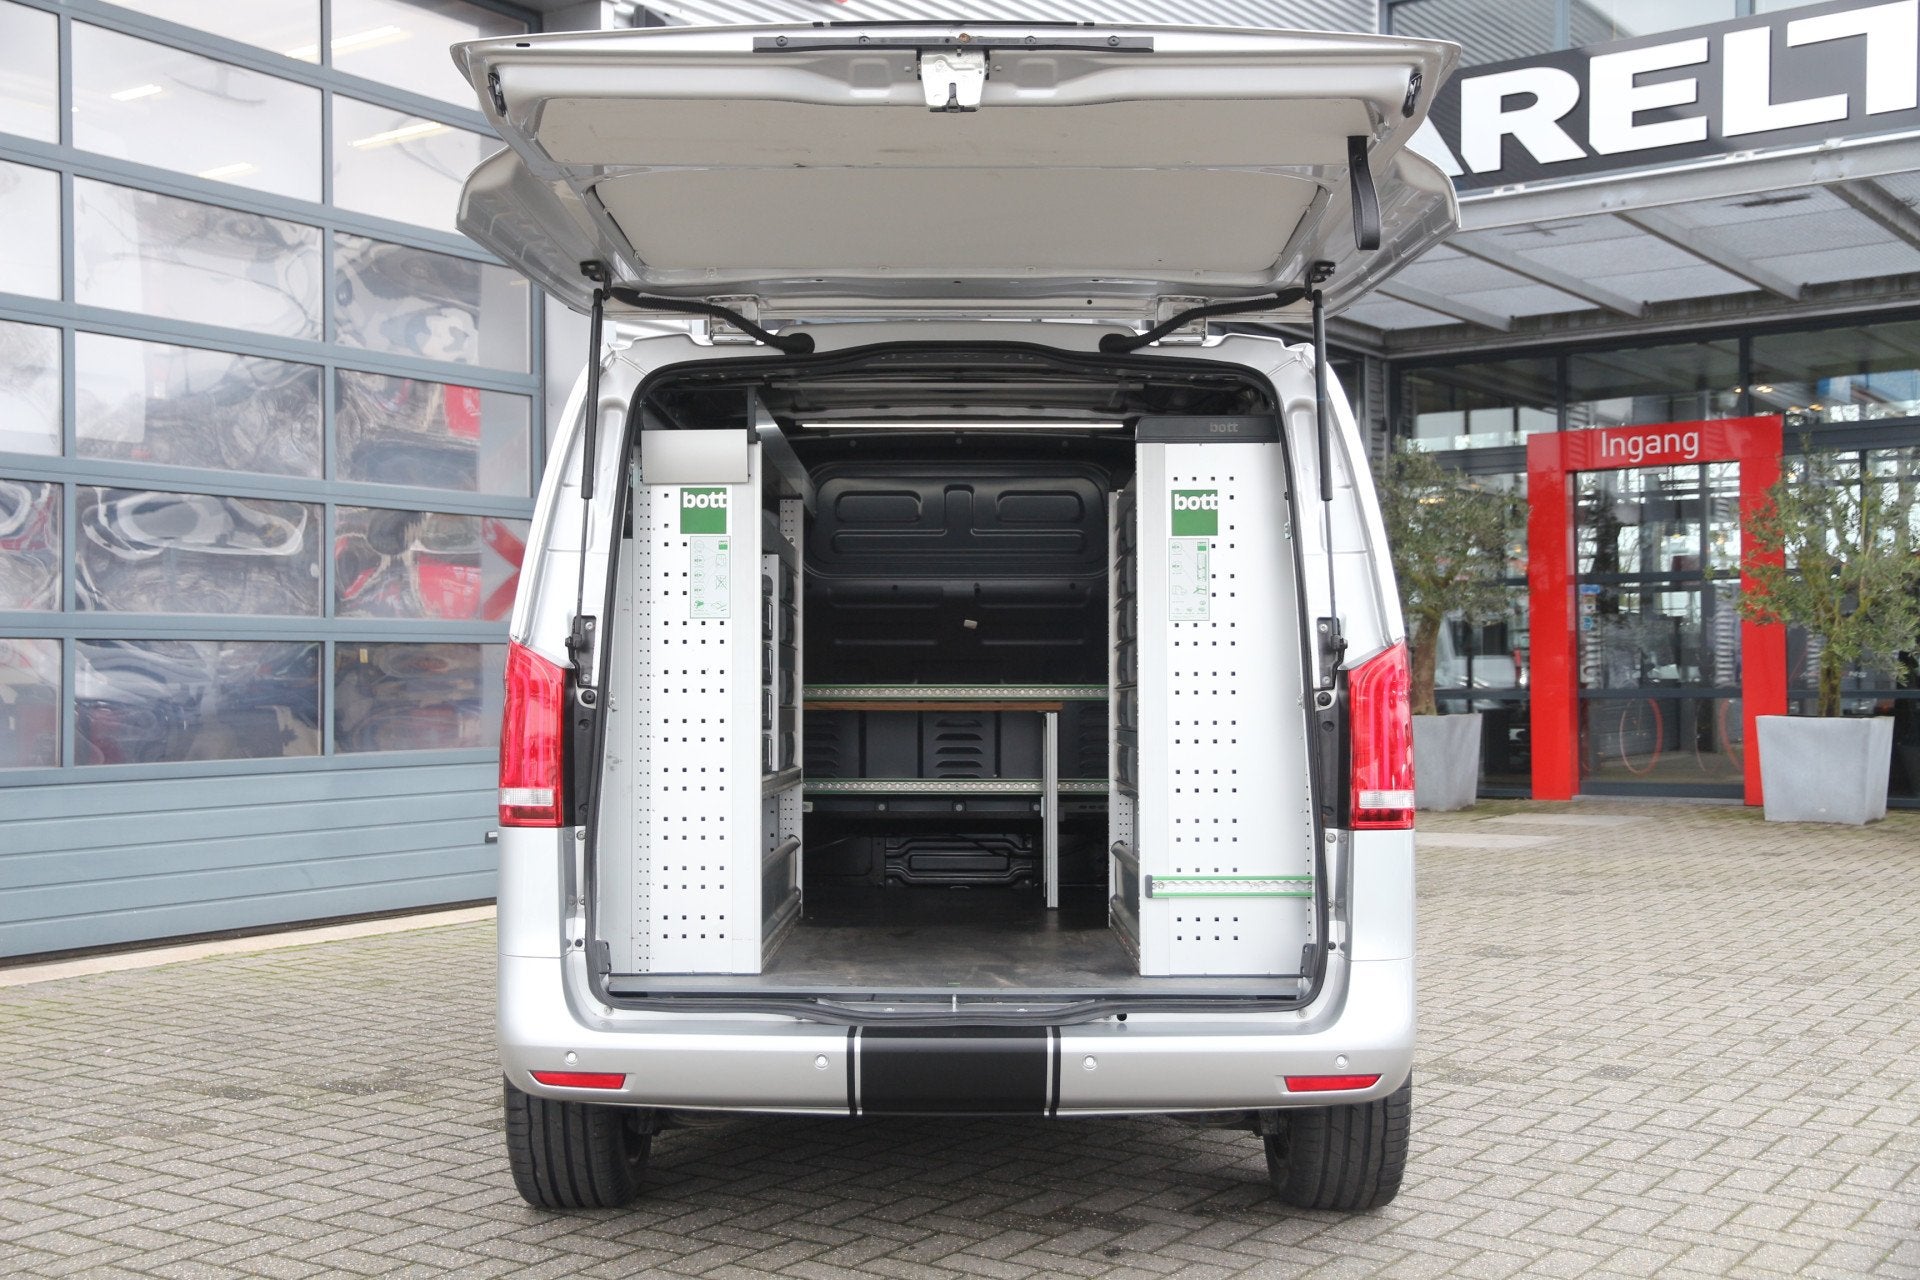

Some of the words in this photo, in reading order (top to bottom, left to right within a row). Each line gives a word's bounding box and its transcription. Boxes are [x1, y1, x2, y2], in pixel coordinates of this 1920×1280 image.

[1601, 431, 1699, 463] Ingang
[682, 491, 727, 508] bott
[1174, 493, 1218, 510] bott
